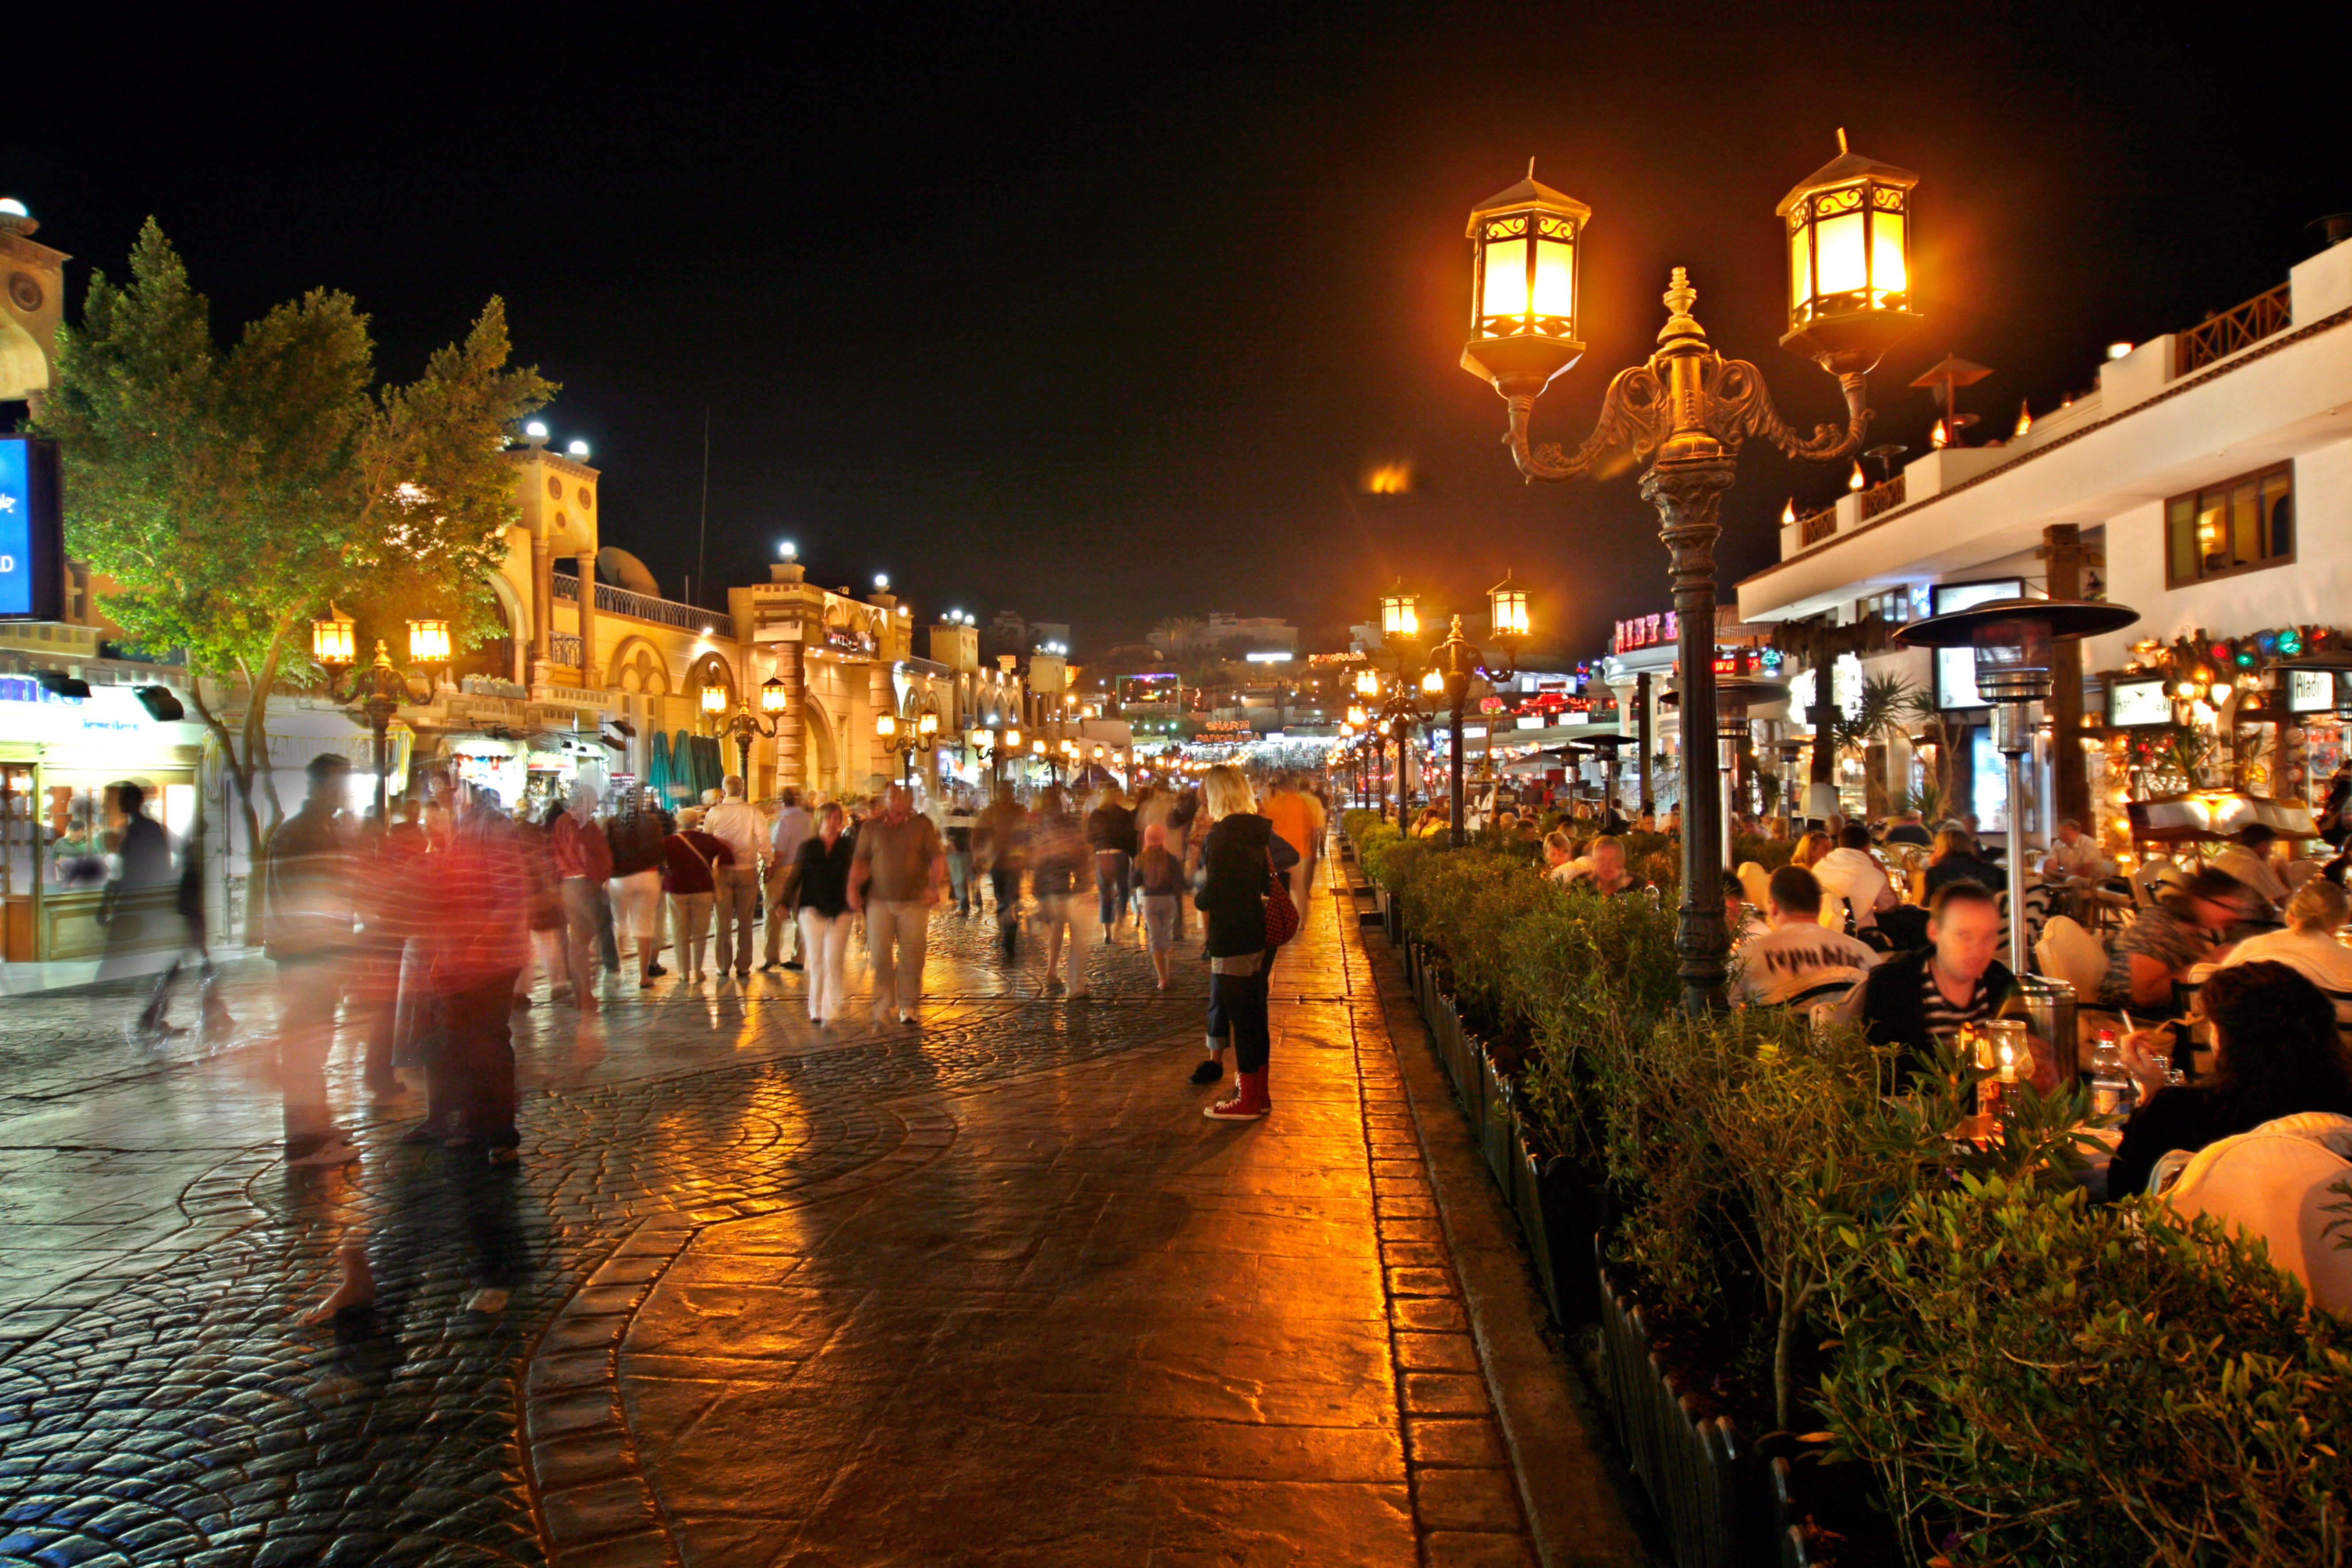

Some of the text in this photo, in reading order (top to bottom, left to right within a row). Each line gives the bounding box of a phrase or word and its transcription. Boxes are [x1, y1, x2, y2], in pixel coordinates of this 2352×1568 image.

[0, 555, 13, 572] D
[1309, 651, 1367, 662] PANORAMA
[1205, 720, 1250, 731] SHARM
[1195, 732, 1262, 742] PANORAMA
